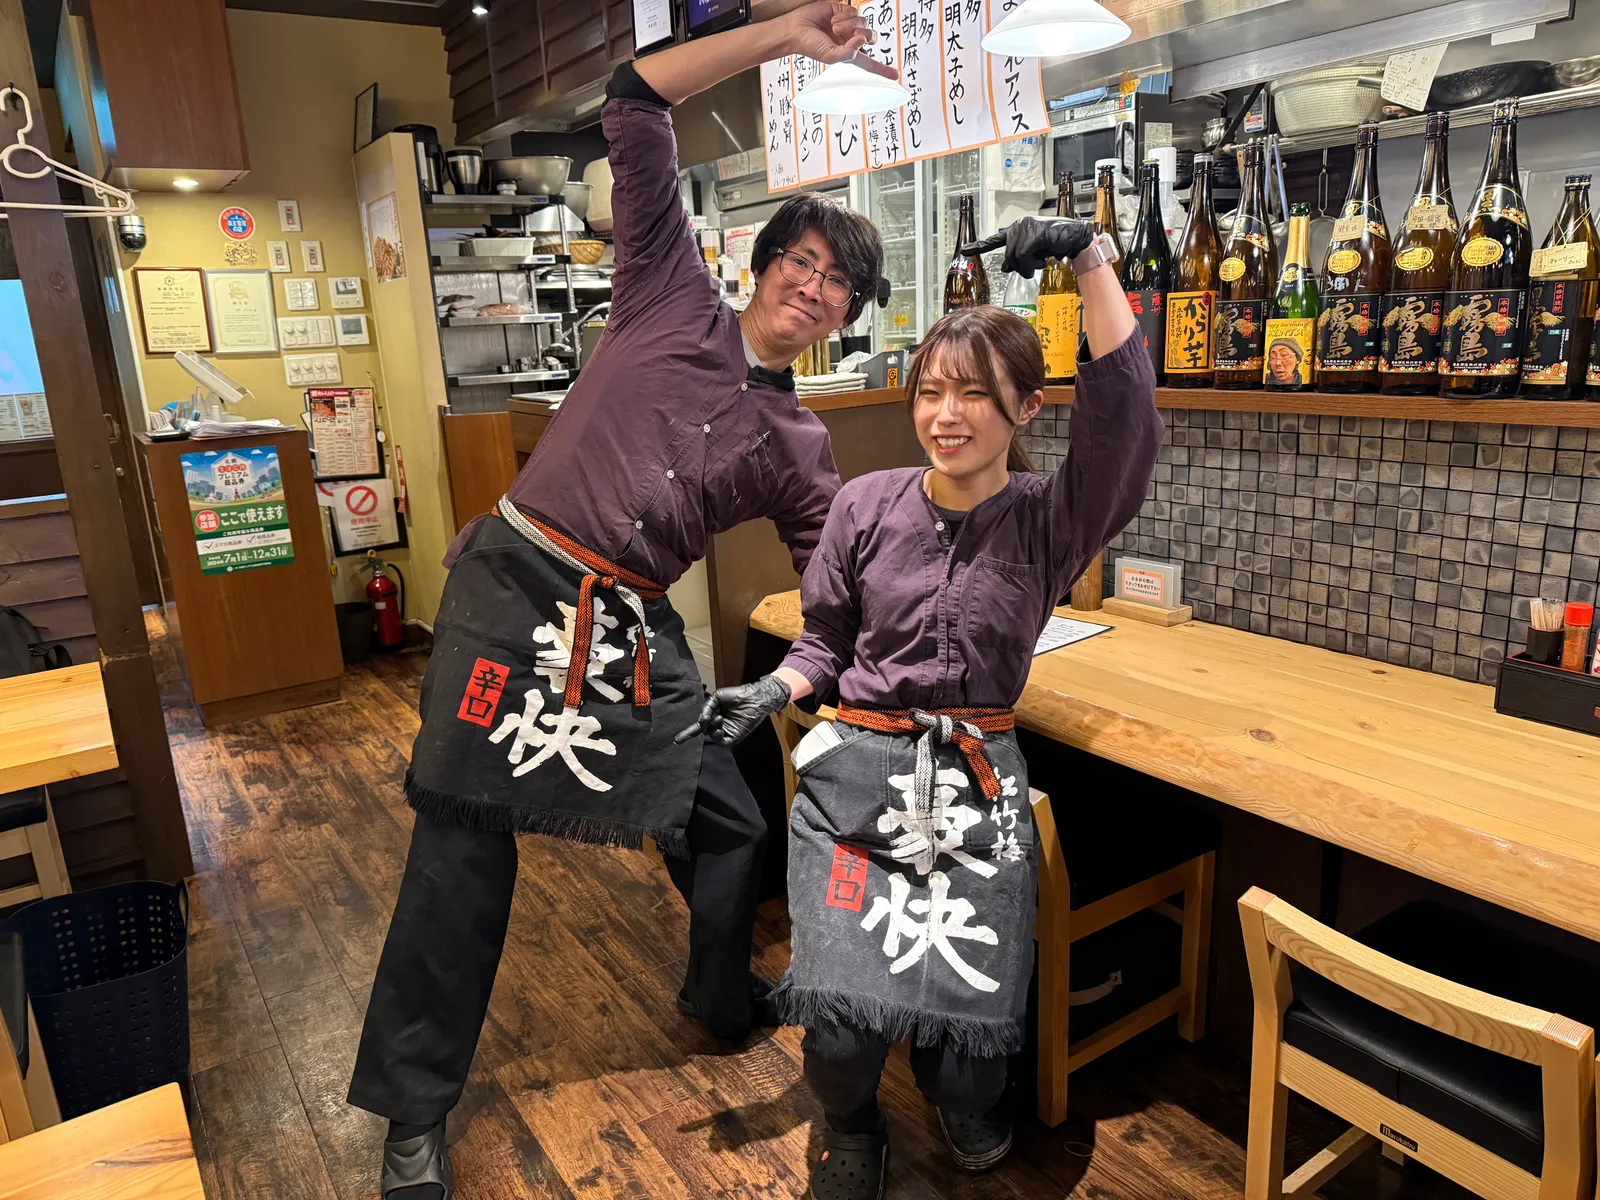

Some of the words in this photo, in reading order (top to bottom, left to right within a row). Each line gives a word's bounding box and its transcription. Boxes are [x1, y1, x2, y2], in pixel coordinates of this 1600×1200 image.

[901, 12, 923, 150] 胡麻さばめし
[945, 2, 965, 125] 明太子めし
[766, 83, 779, 153] らーめん
[1182, 297, 1207, 369] からり芋
[1326, 298, 1355, 359] 霧島
[1394, 296, 1426, 360] 霧島
[1456, 294, 1492, 361] 霧島
[217, 471, 249, 480] プレミアム
[224, 478, 245, 486] 商品券
[200, 520, 217, 529] 店舗
[220, 504, 284, 526] ここで使えます
[466, 665, 502, 719] 辛口
[833, 850, 866, 903] 辛口
